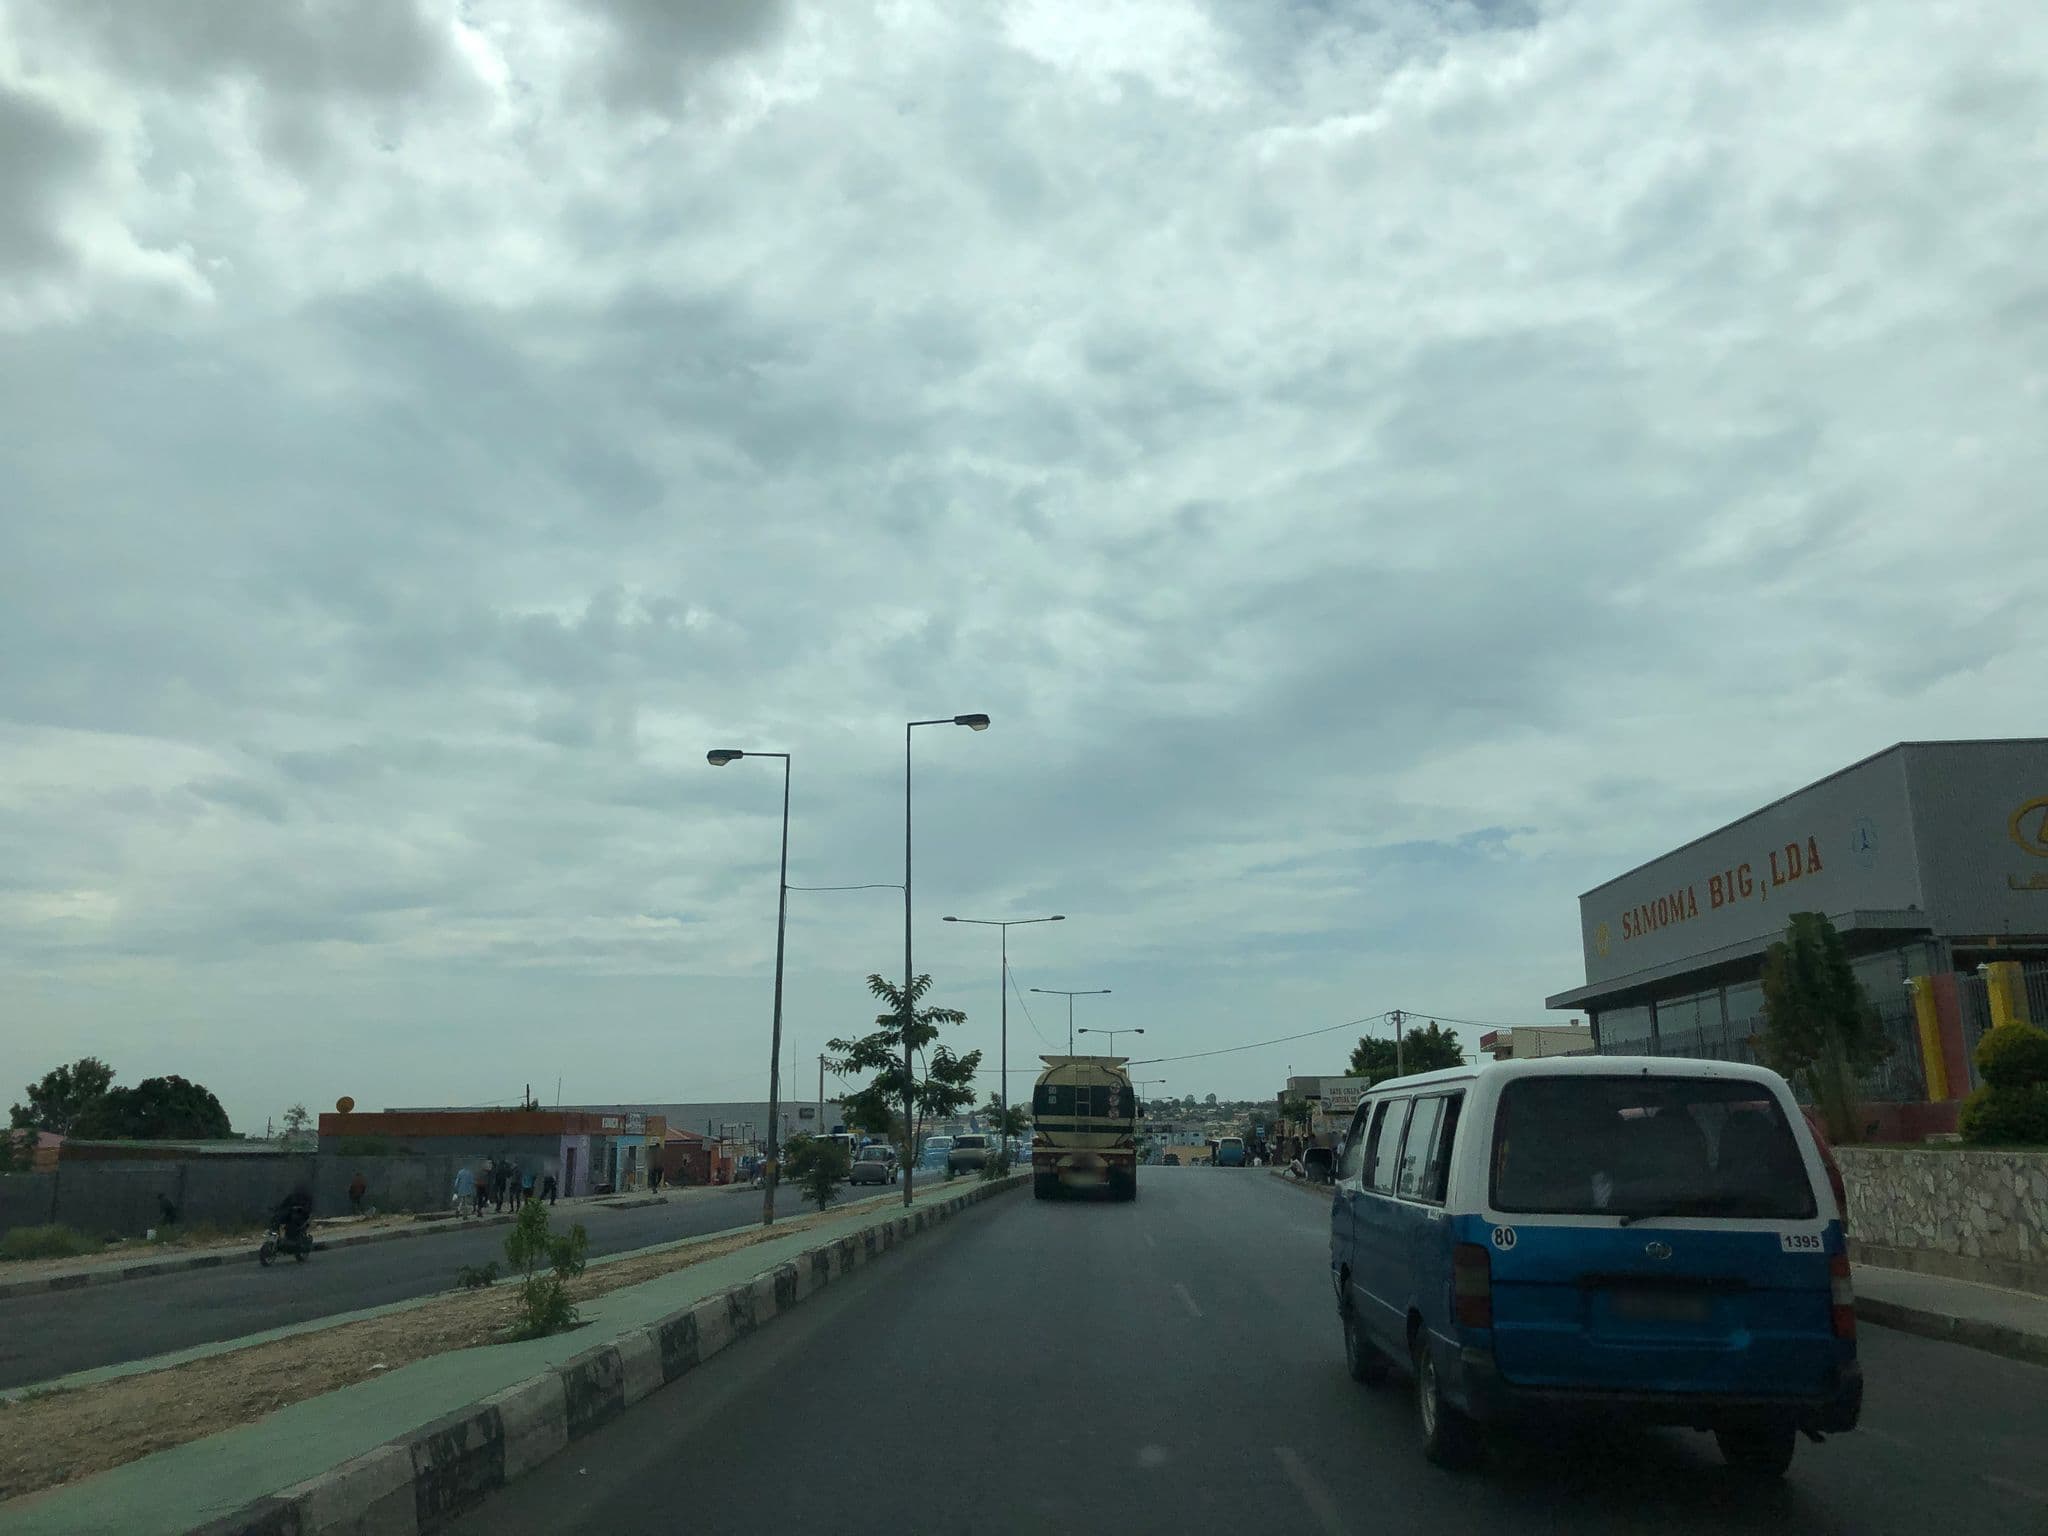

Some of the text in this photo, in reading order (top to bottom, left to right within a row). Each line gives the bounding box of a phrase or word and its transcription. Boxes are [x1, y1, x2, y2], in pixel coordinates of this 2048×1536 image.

[1622, 885, 1699, 941] SAMOMA
[1495, 1228, 1514, 1246] 80
[1785, 1235, 1819, 1248] 1395
